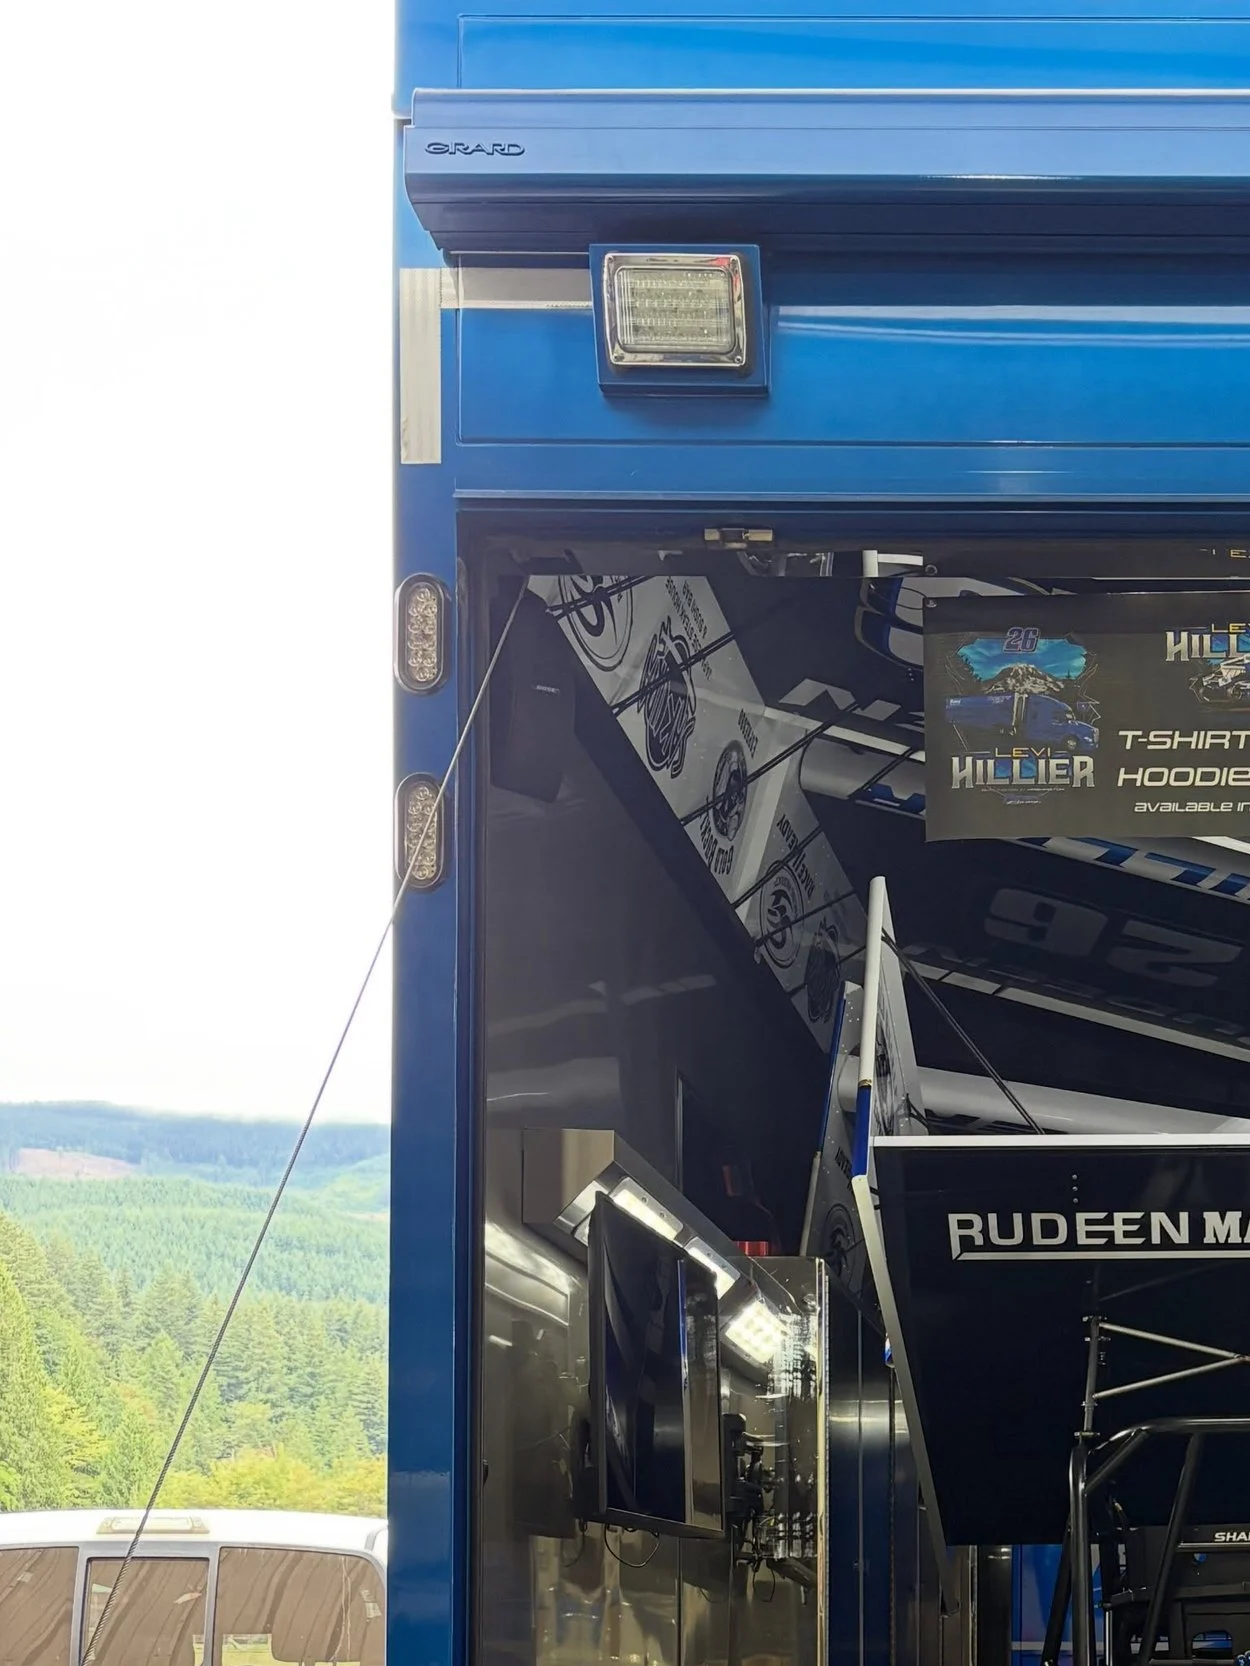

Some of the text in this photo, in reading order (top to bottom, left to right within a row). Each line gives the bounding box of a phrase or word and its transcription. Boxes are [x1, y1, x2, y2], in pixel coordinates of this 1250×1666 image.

[1003, 627, 1040, 654] 26
[995, 747, 1051, 758] LEVI
[952, 755, 1095, 789] HILLIER
[948, 1210, 1191, 1248] RUDEEN
